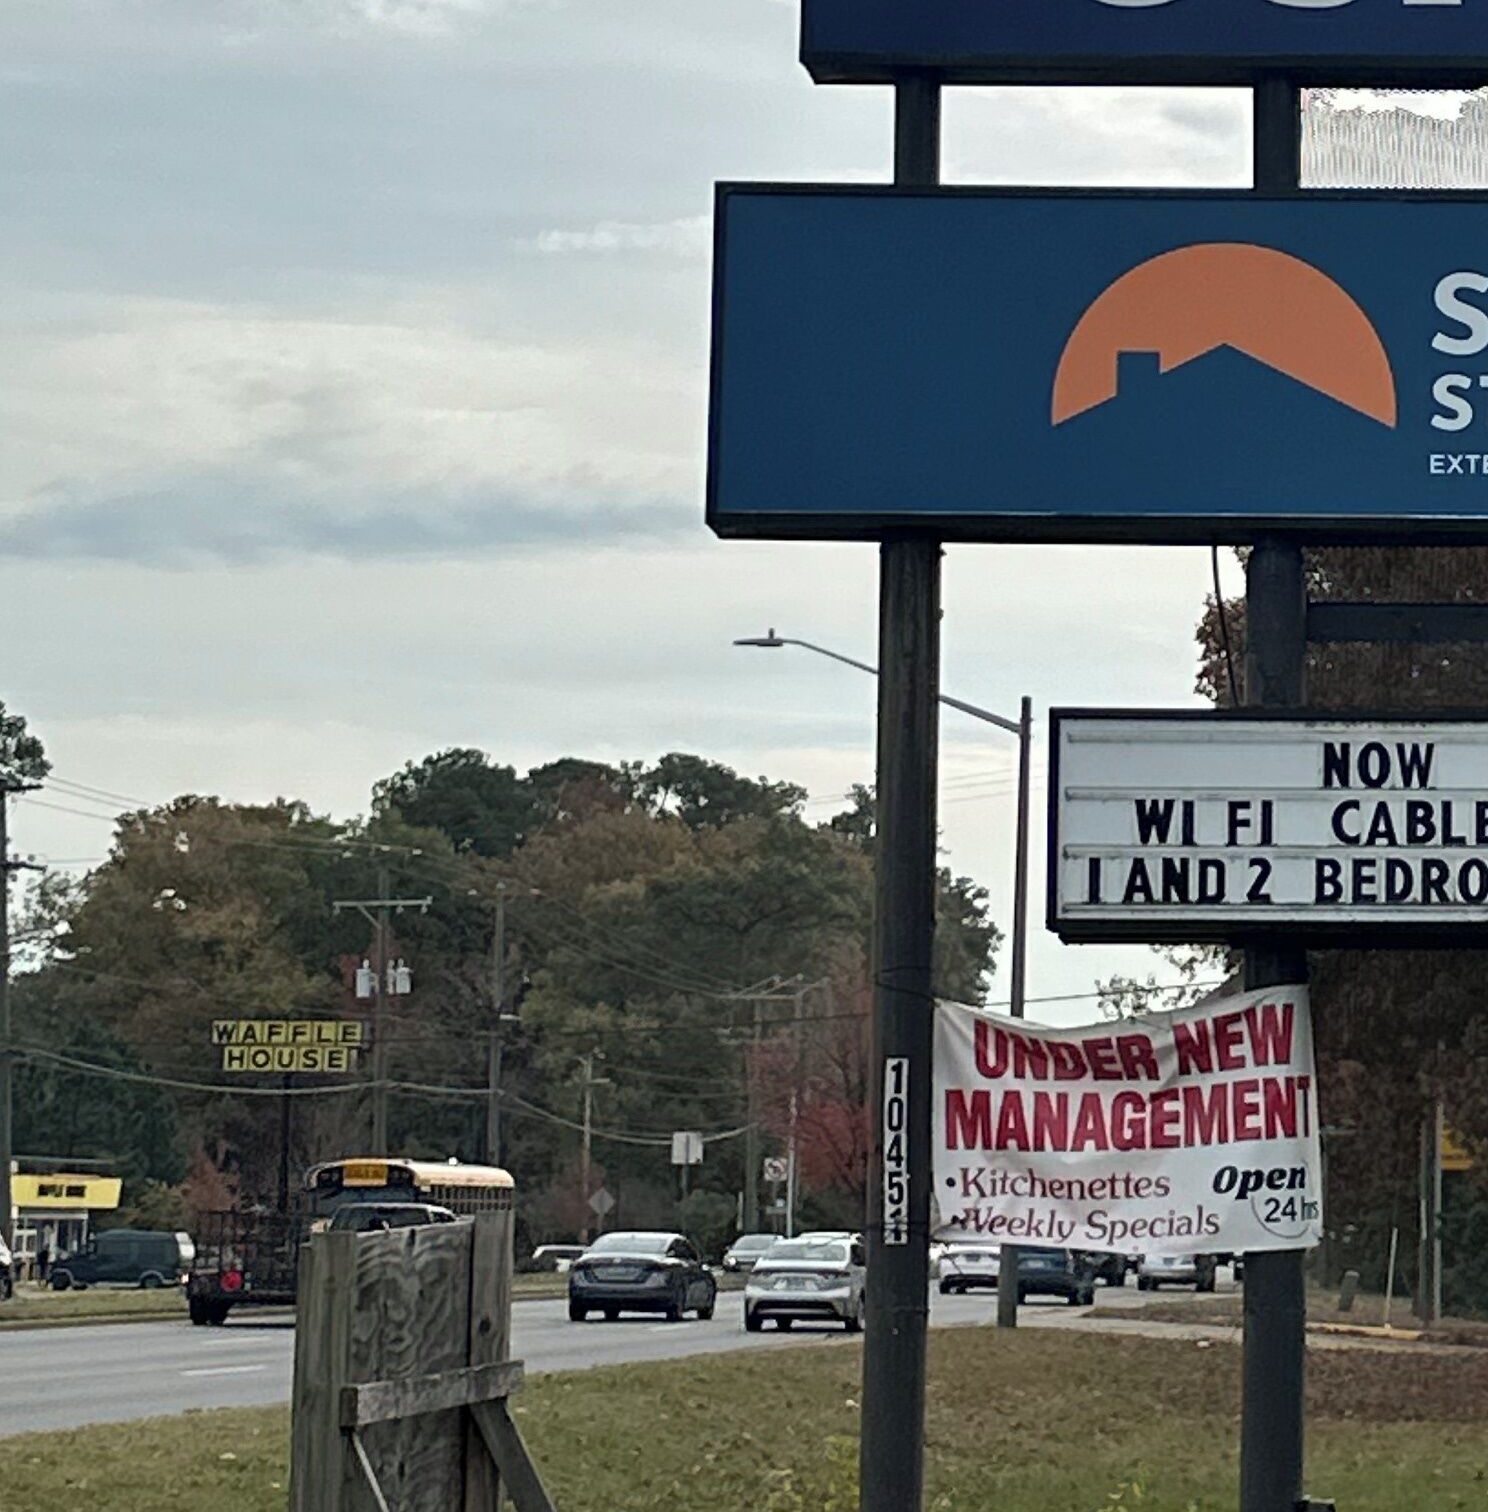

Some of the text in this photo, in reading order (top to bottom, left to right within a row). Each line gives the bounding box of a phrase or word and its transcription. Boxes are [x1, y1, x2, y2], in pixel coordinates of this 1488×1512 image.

[1323, 742, 1435, 788] NOW
[1122, 857, 1227, 904] AND
[1246, 857, 1272, 905] 2
[214, 1023, 359, 1043] WAFFLE
[974, 1003, 1294, 1081] UNDER NEW
[227, 1049, 343, 1068] HOUSE
[945, 1075, 1311, 1152] MANAGEMENT
[960, 1167, 1171, 1200] Kitchenettes
[1212, 1165, 1306, 1200] Open
[1085, 1205, 1220, 1245] Specials
